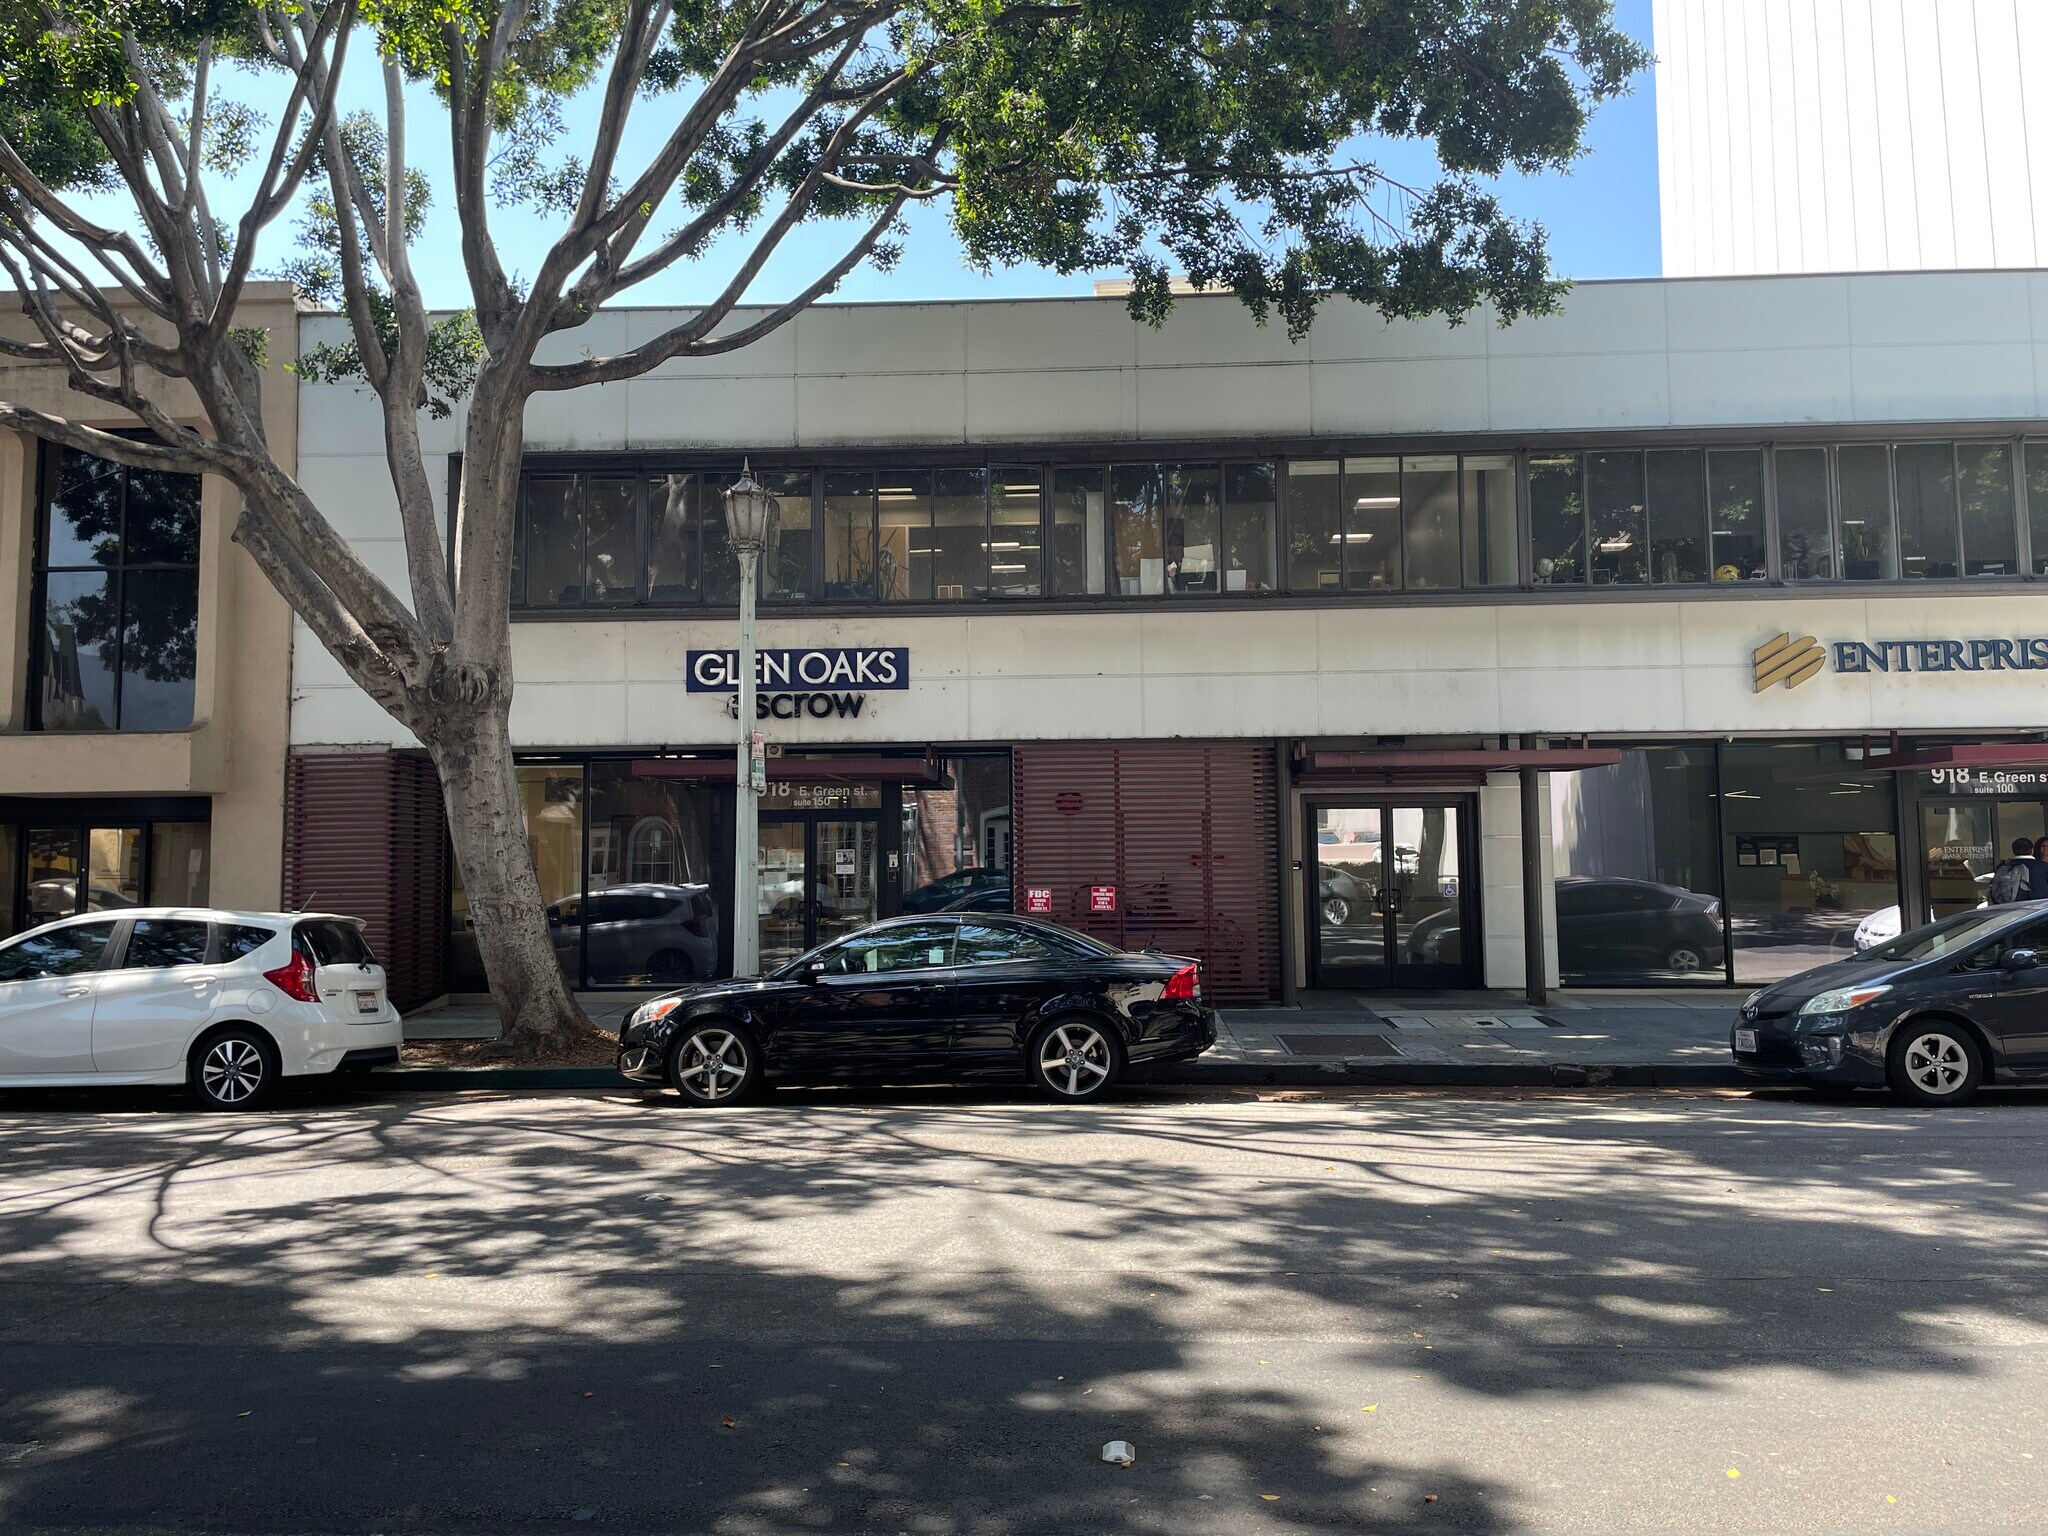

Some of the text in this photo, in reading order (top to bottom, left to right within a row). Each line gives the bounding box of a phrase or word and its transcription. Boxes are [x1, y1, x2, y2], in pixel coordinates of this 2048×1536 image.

[1833, 638, 2048, 673] ENTERPRIS
[799, 650, 898, 685] OAKS
[1931, 768, 1970, 784] 918
[1994, 771, 2036, 783] Green
[813, 785, 850, 796] Green
[853, 786, 868, 796] st.
[1974, 784, 2014, 794] suite 100
[793, 797, 830, 806] suite 150
[1944, 846, 1988, 854] ENTERPRISE
[1029, 890, 1050, 898] FDC
